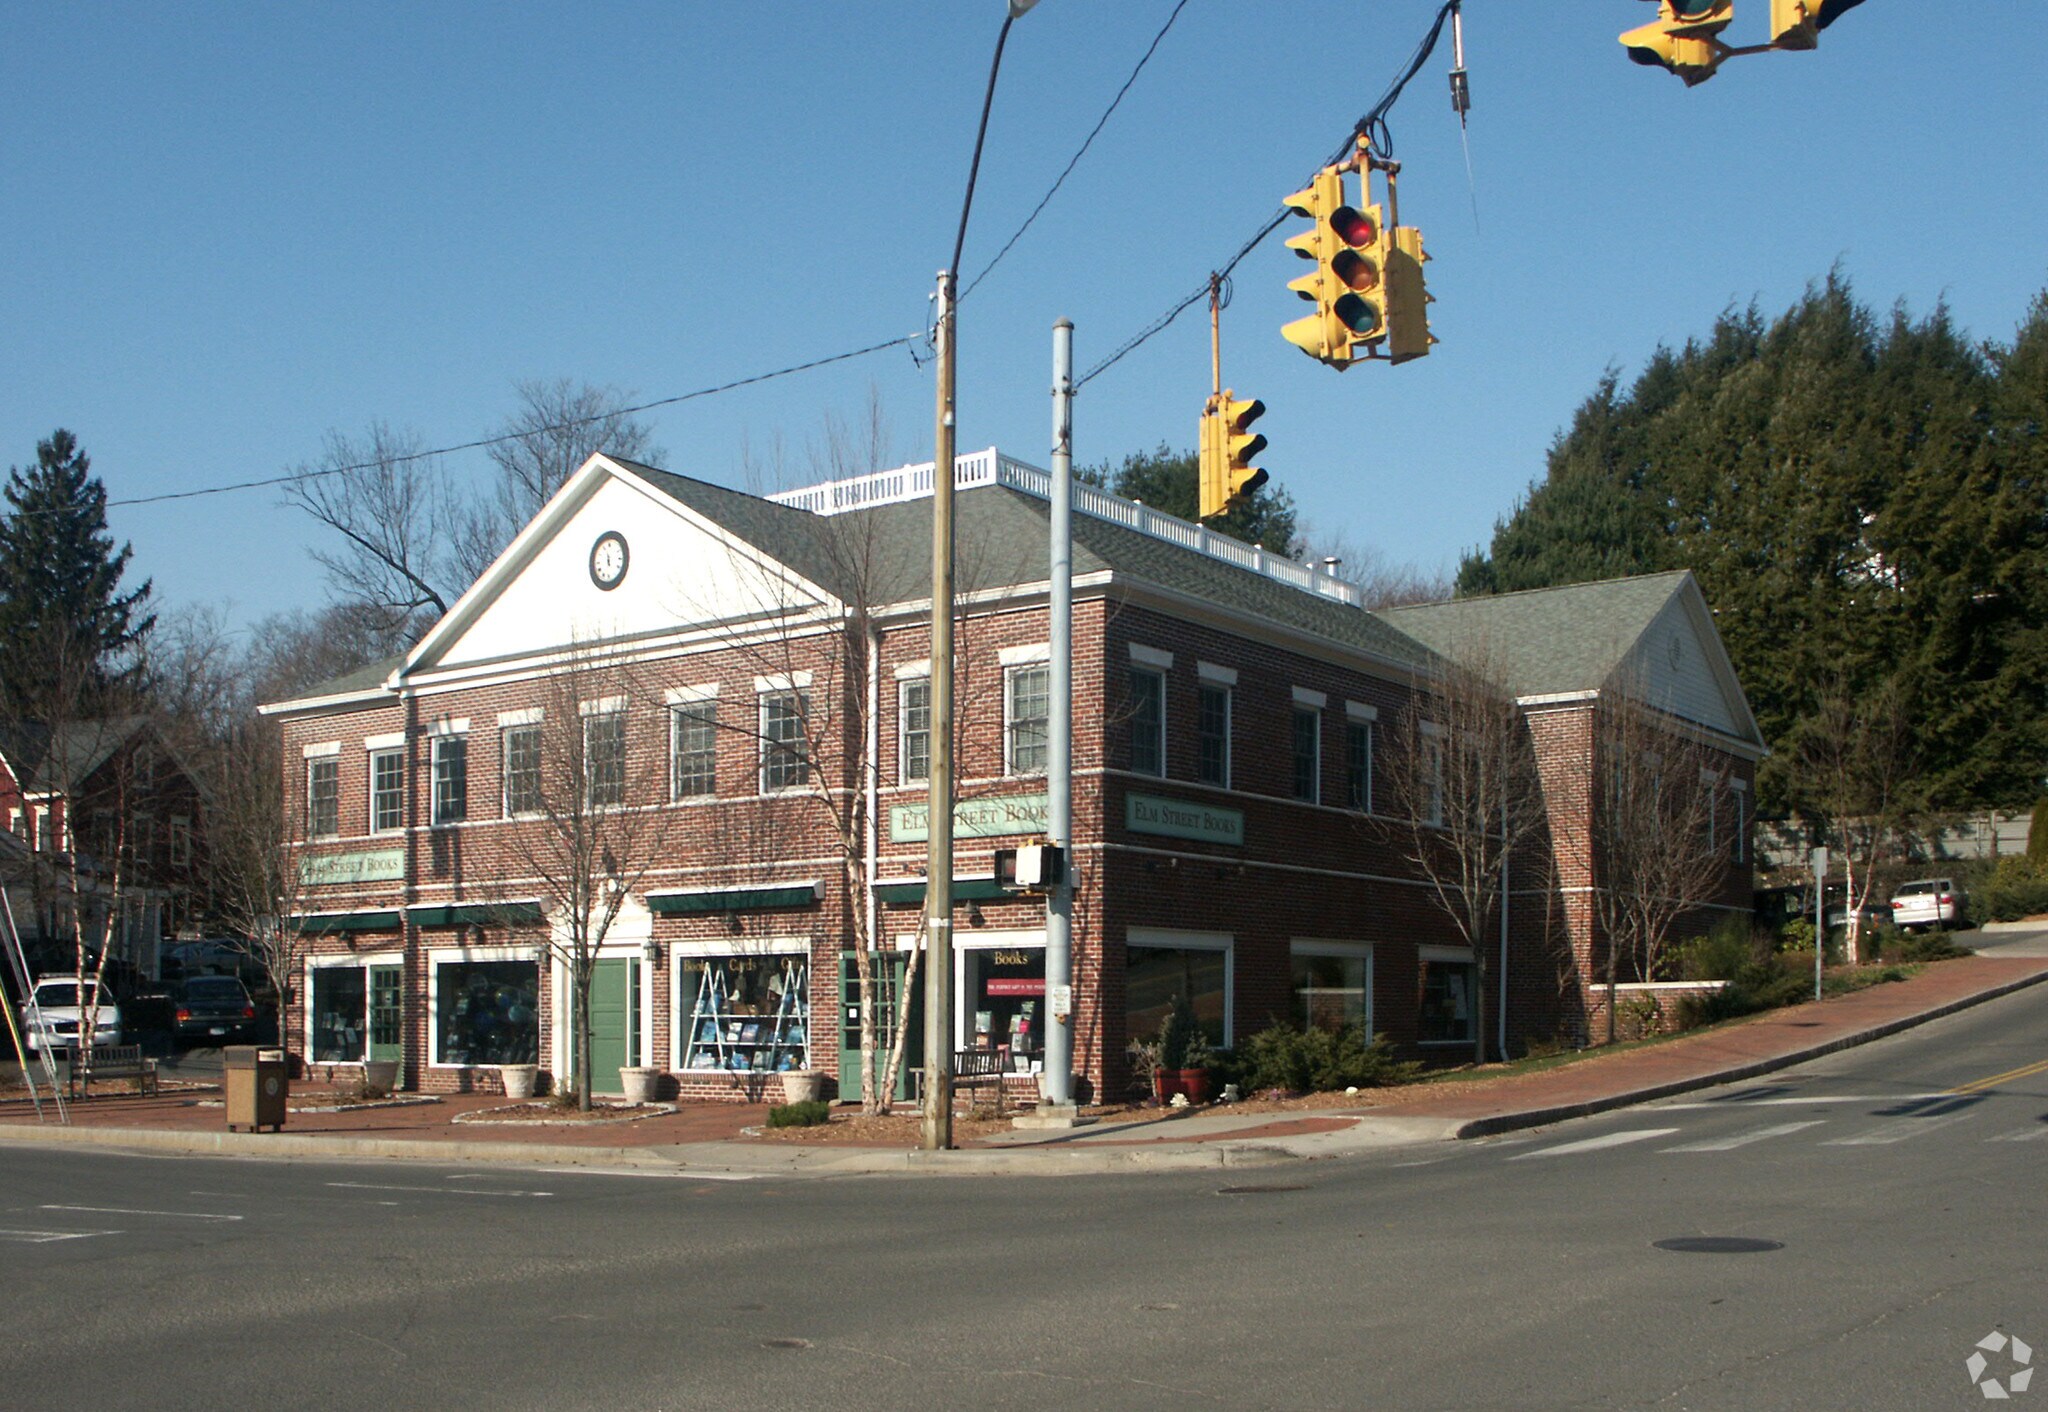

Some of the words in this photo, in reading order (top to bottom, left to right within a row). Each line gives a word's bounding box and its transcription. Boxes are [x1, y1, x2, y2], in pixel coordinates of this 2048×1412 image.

[1005, 804, 1048, 822] BOOK
[1135, 801, 1158, 823] ELM
[1162, 805, 1200, 828] STREET
[1204, 812, 1236, 834] BOOKS
[367, 858, 398, 871] BOOKS
[994, 951, 1028, 965] Books
